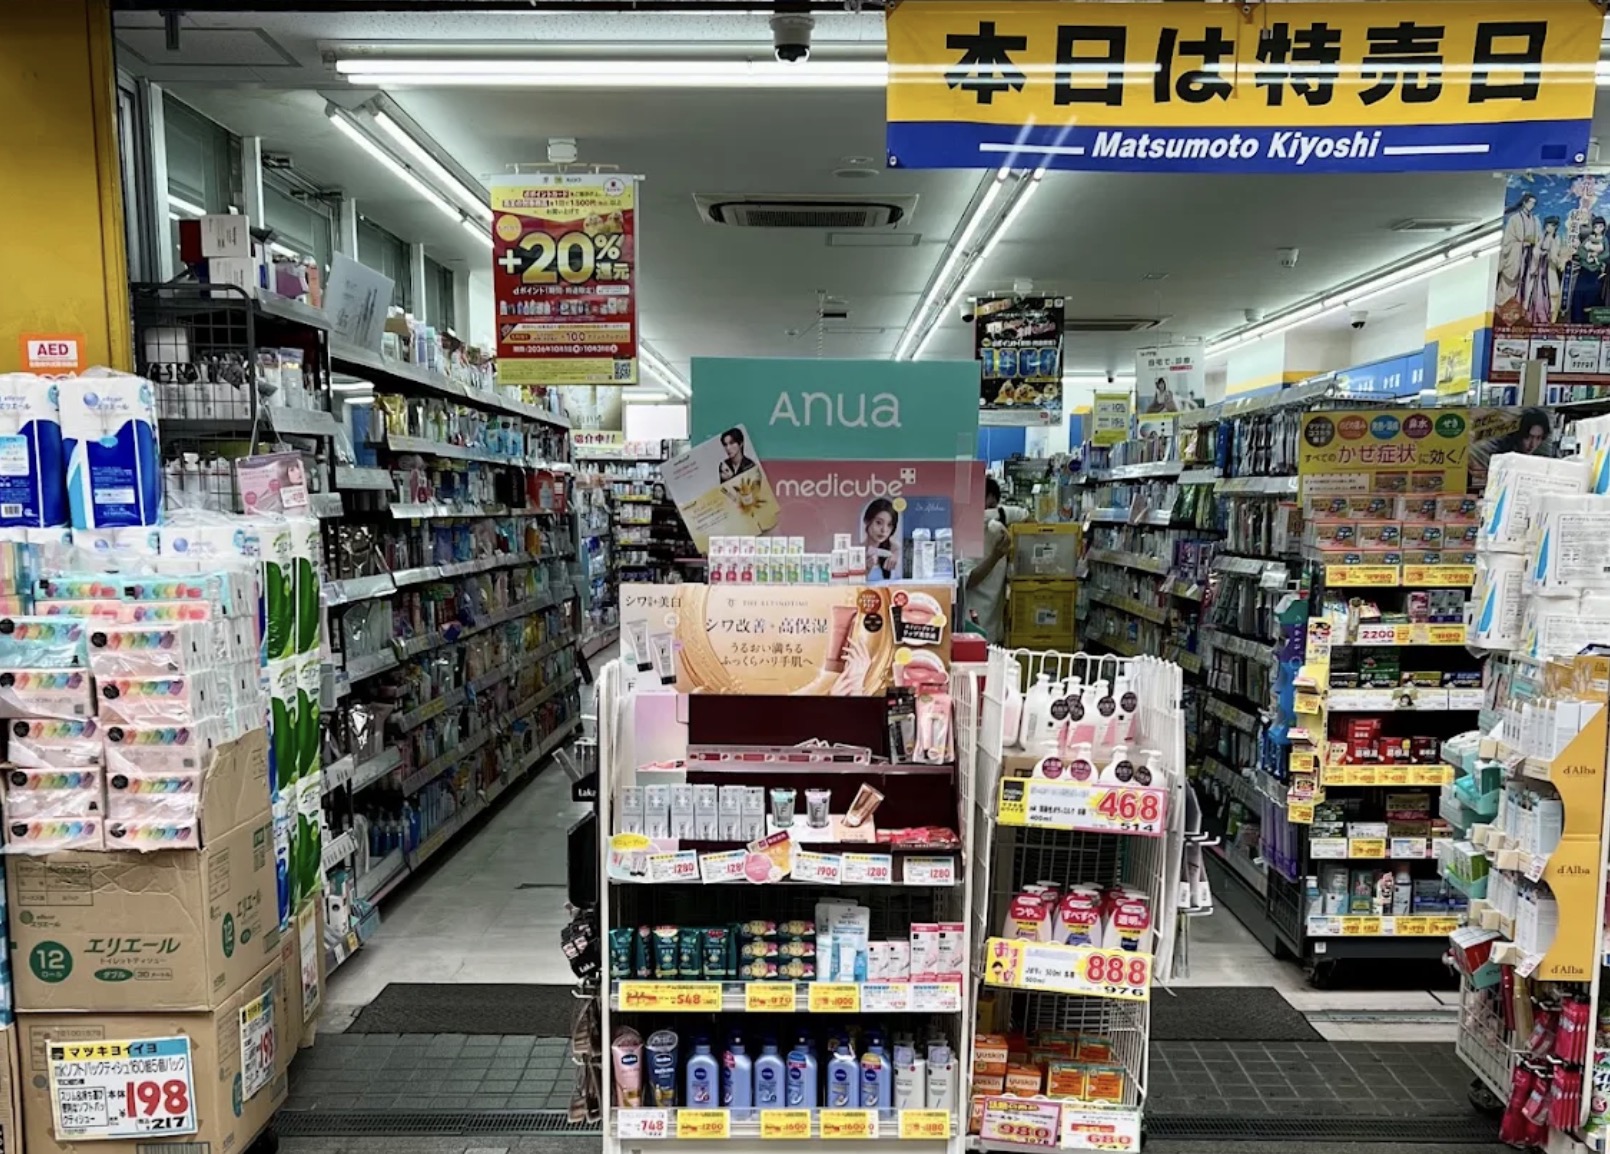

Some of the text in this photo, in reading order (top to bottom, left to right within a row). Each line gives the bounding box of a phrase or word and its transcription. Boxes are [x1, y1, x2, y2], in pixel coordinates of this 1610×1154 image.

[943, 20, 1549, 106] 本日は特売日
[1092, 129, 1381, 167] Matsumoto Kiyoshi
[596, 262, 630, 281] 還元
[37, 343, 69, 356] AED
[768, 391, 902, 428] Anua
[774, 473, 902, 498] medicube
[706, 616, 829, 635] シワ改善・高保湿
[1362, 630, 1396, 639] 2200
[731, 641, 803, 654] うるおい満ちる
[719, 655, 814, 668] ふっくらハリ手肌へ
[1096, 788, 1160, 824] 468
[1120, 822, 1154, 833] 514
[84, 937, 181, 958] エリエール
[36, 949, 65, 970] 12
[1086, 952, 1148, 988] 888
[1103, 984, 1145, 997] 976
[676, 994, 702, 1005] 548
[68, 1043, 158, 1058] マツキヨイイヨ
[975, 1051, 1005, 1060] yuskin
[1008, 1076, 1039, 1086] yuskin
[108, 1089, 126, 1099] 本体
[126, 1079, 189, 1118] 198
[150, 1116, 186, 1130] 217
[640, 1120, 665, 1131] 748
[1000, 1123, 1051, 1139] 980
[1087, 1133, 1133, 1145] 680
